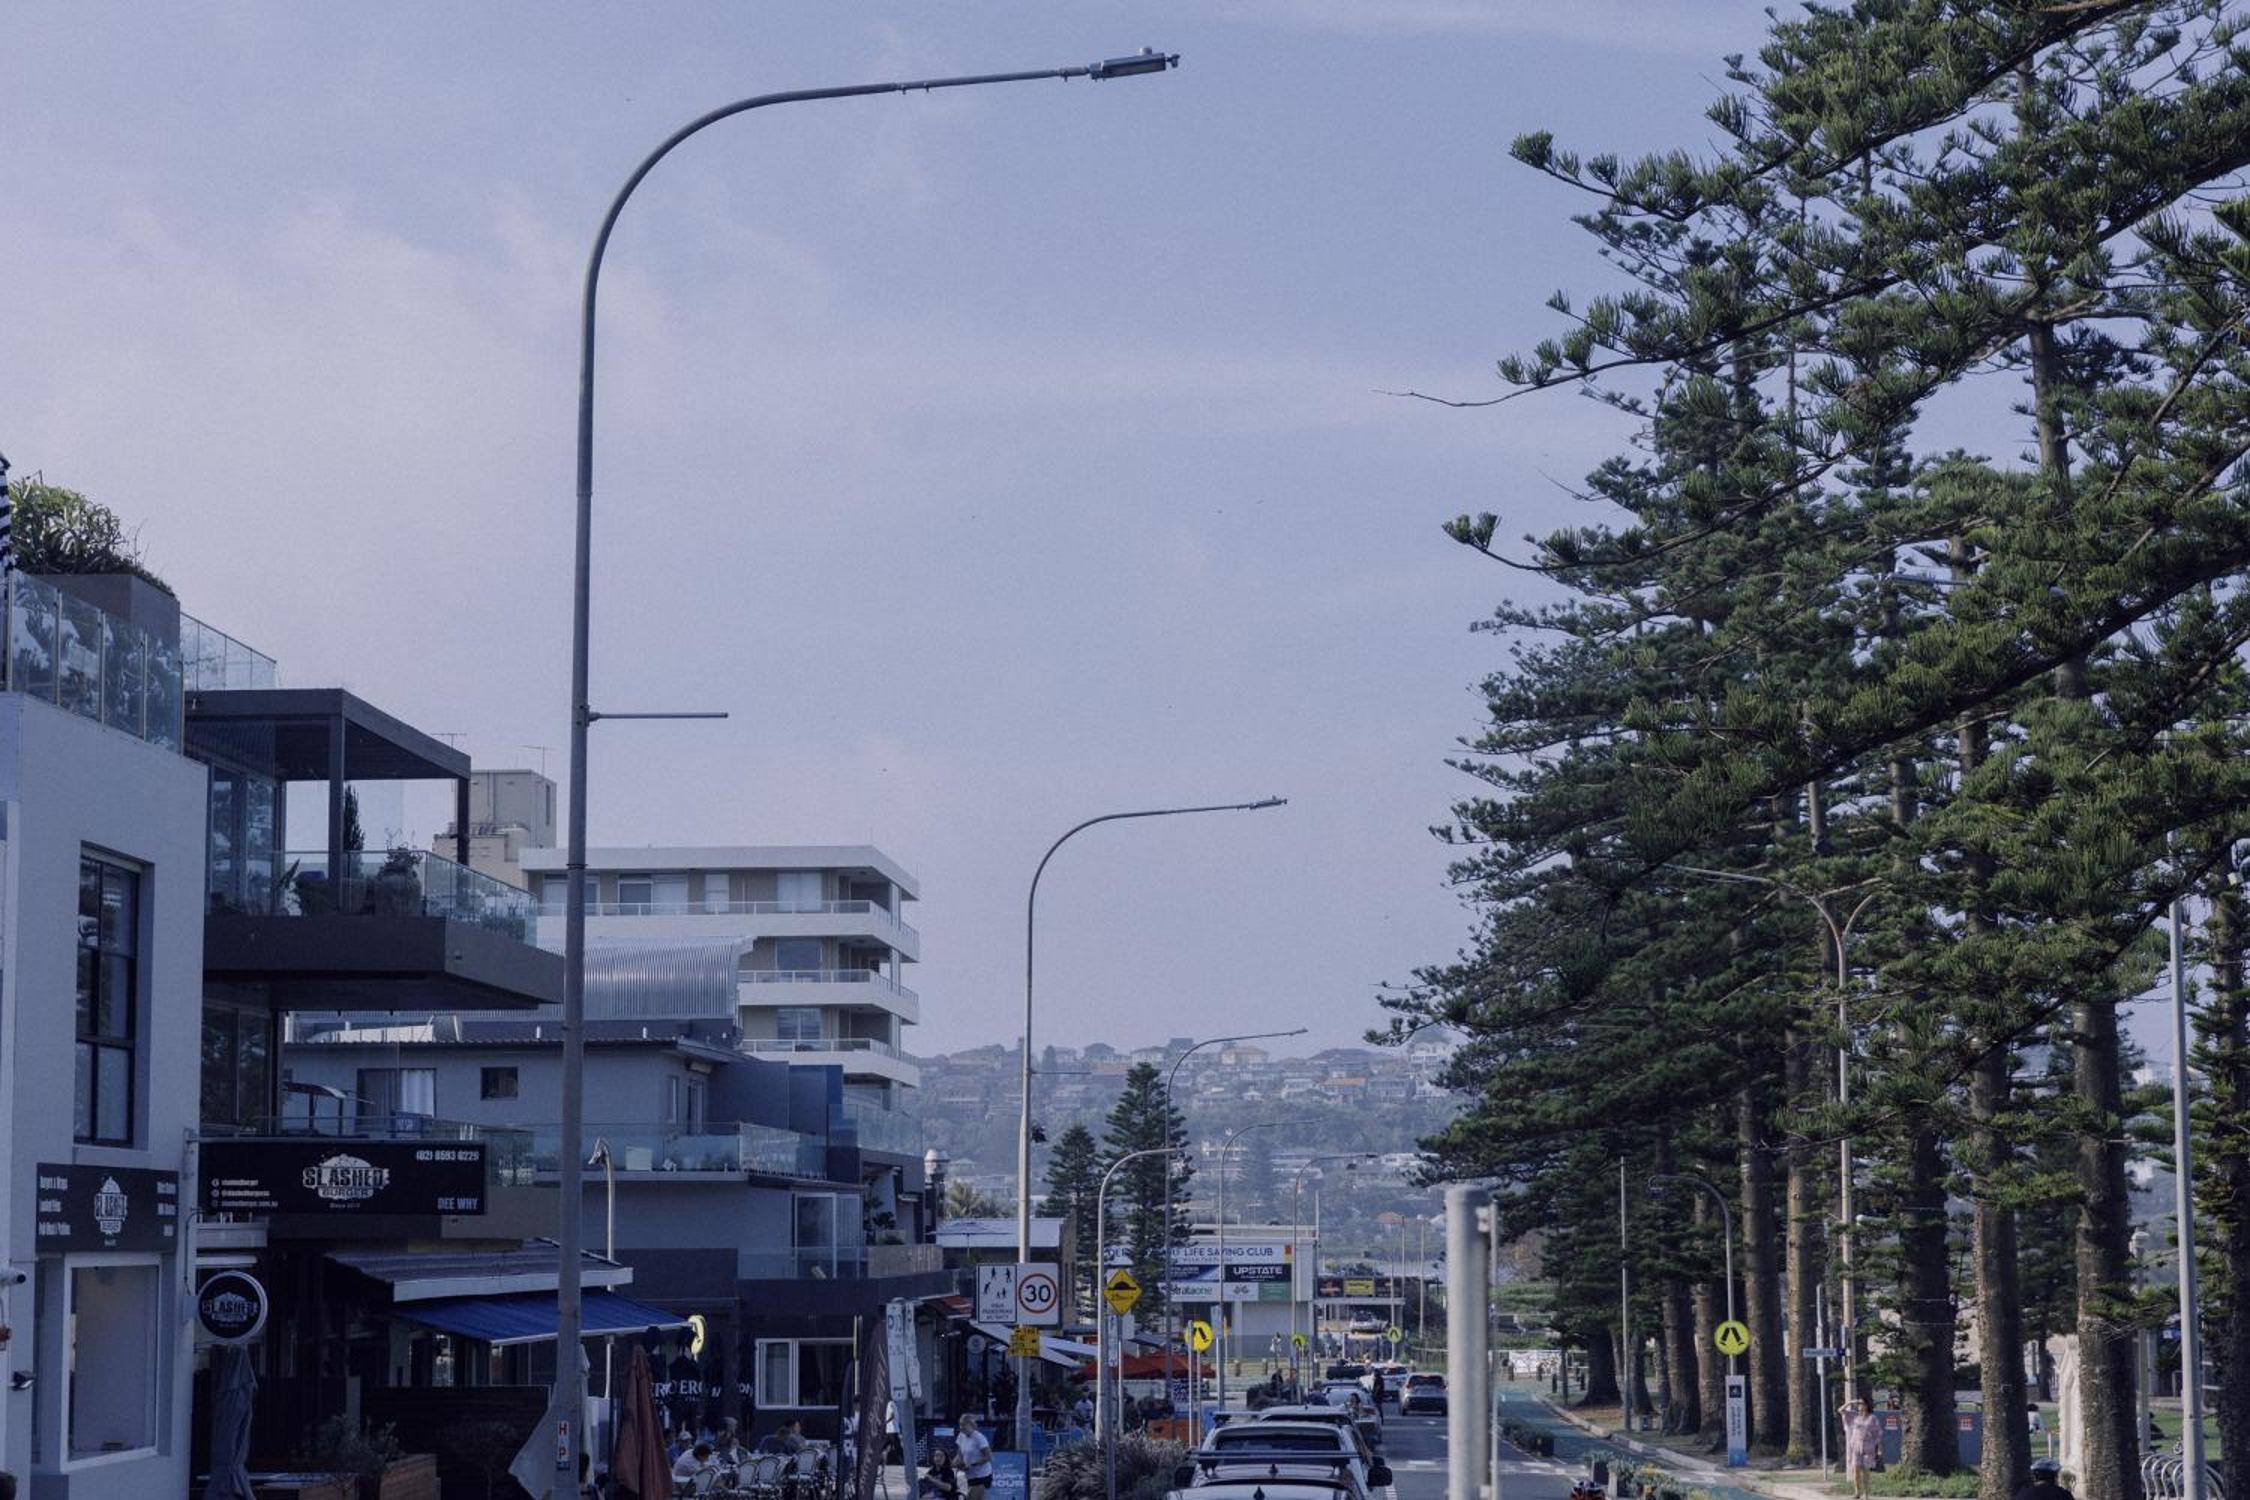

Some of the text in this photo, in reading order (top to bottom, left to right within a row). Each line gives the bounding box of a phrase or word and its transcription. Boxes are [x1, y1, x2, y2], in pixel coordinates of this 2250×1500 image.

[303, 1167, 386, 1189] SLASHED
[456, 1197, 478, 1210] WHY
[1184, 1247, 1205, 1257] LIFE
[1246, 1246, 1274, 1256] CLUB
[1232, 1266, 1283, 1275] UPSTATE
[1024, 1284, 1051, 1303] 30
